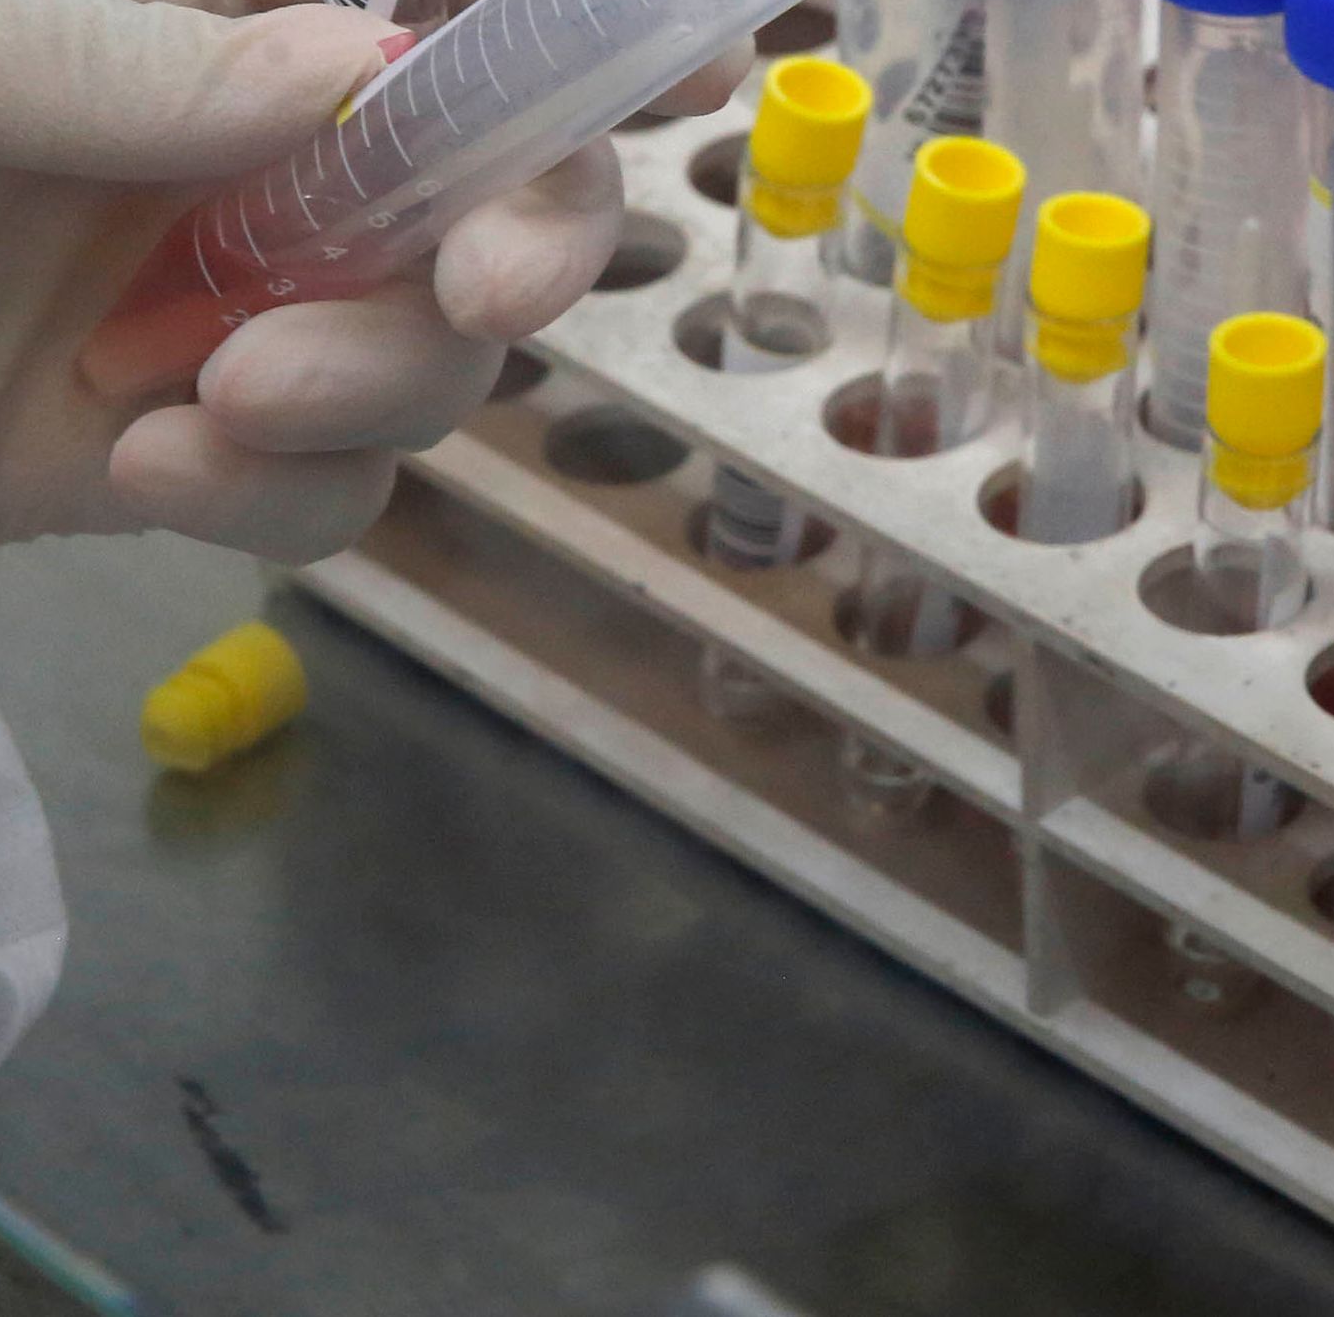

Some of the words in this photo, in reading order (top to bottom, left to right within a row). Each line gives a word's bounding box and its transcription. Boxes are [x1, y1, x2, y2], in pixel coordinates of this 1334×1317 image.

[367, 210, 398, 229] 5
[322, 245, 348, 262] 4
[267, 277, 296, 296] 3
[220, 308, 250, 328] 2
